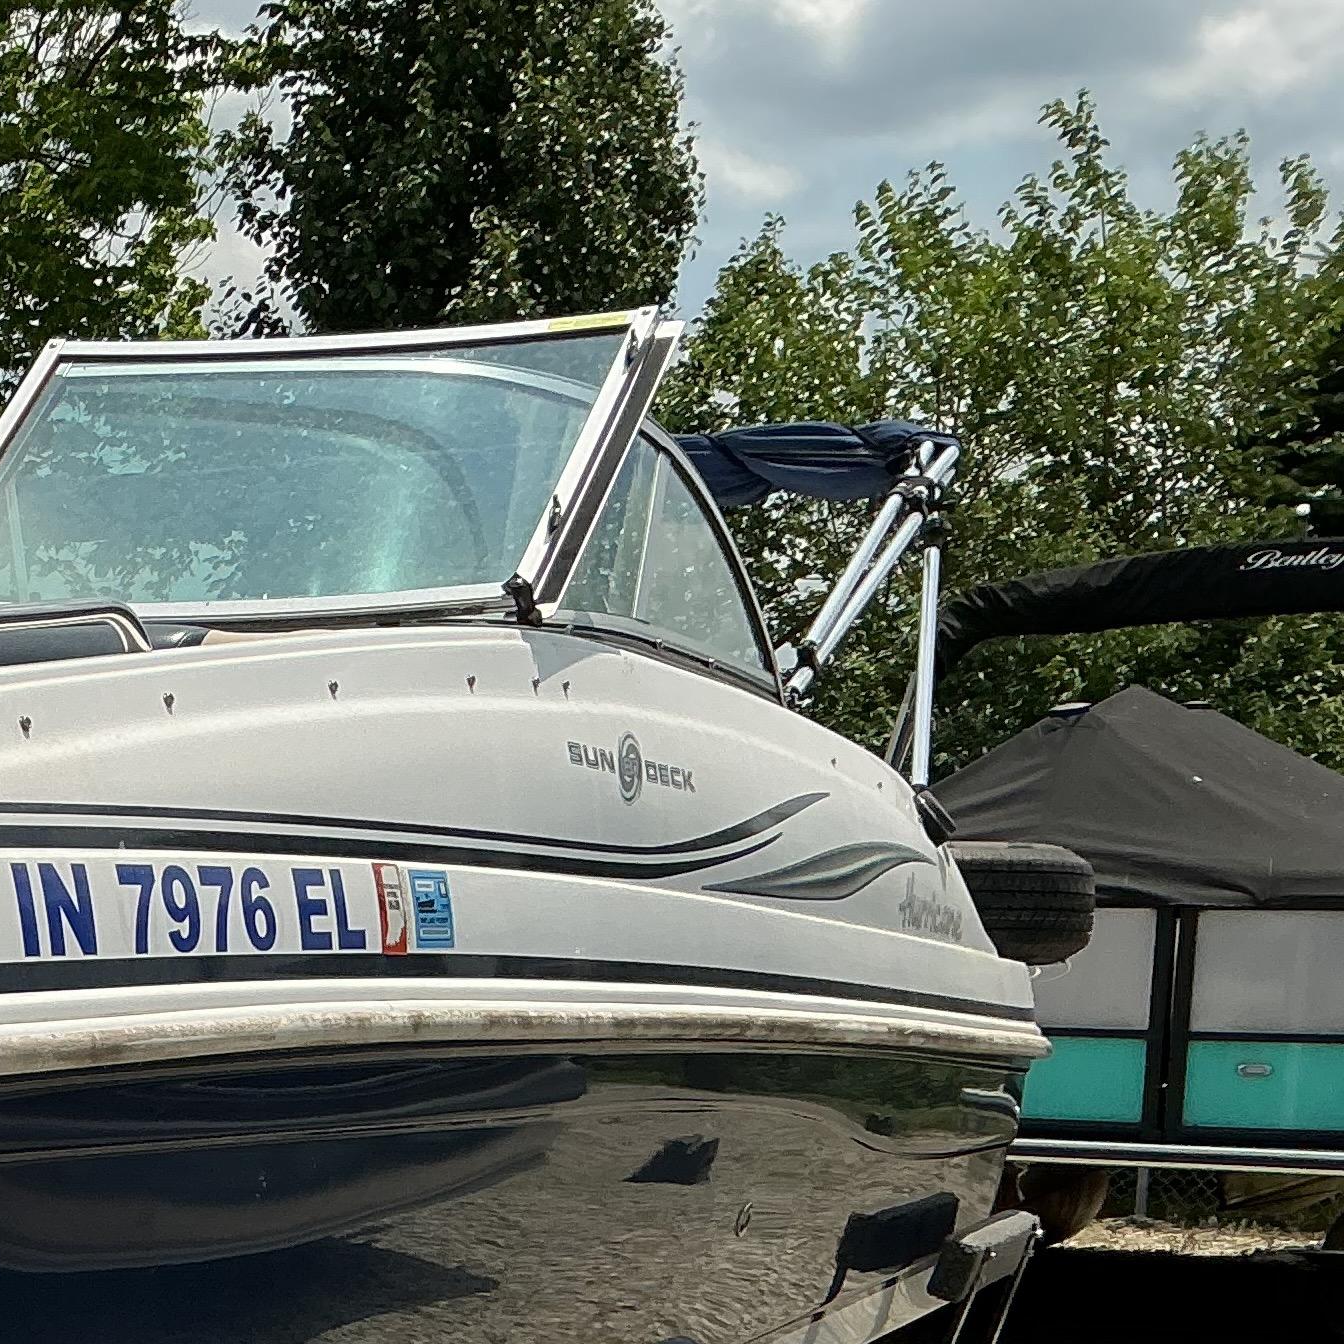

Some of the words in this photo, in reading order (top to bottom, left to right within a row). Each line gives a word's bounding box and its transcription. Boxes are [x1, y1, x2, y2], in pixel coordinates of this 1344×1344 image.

[1240, 547, 1344, 572] Bentley
[567, 741, 616, 774] SUN
[644, 760, 696, 793] DECK
[10, 863, 98, 957] IN
[115, 864, 277, 954] 7976
[291, 867, 366, 951] EL
